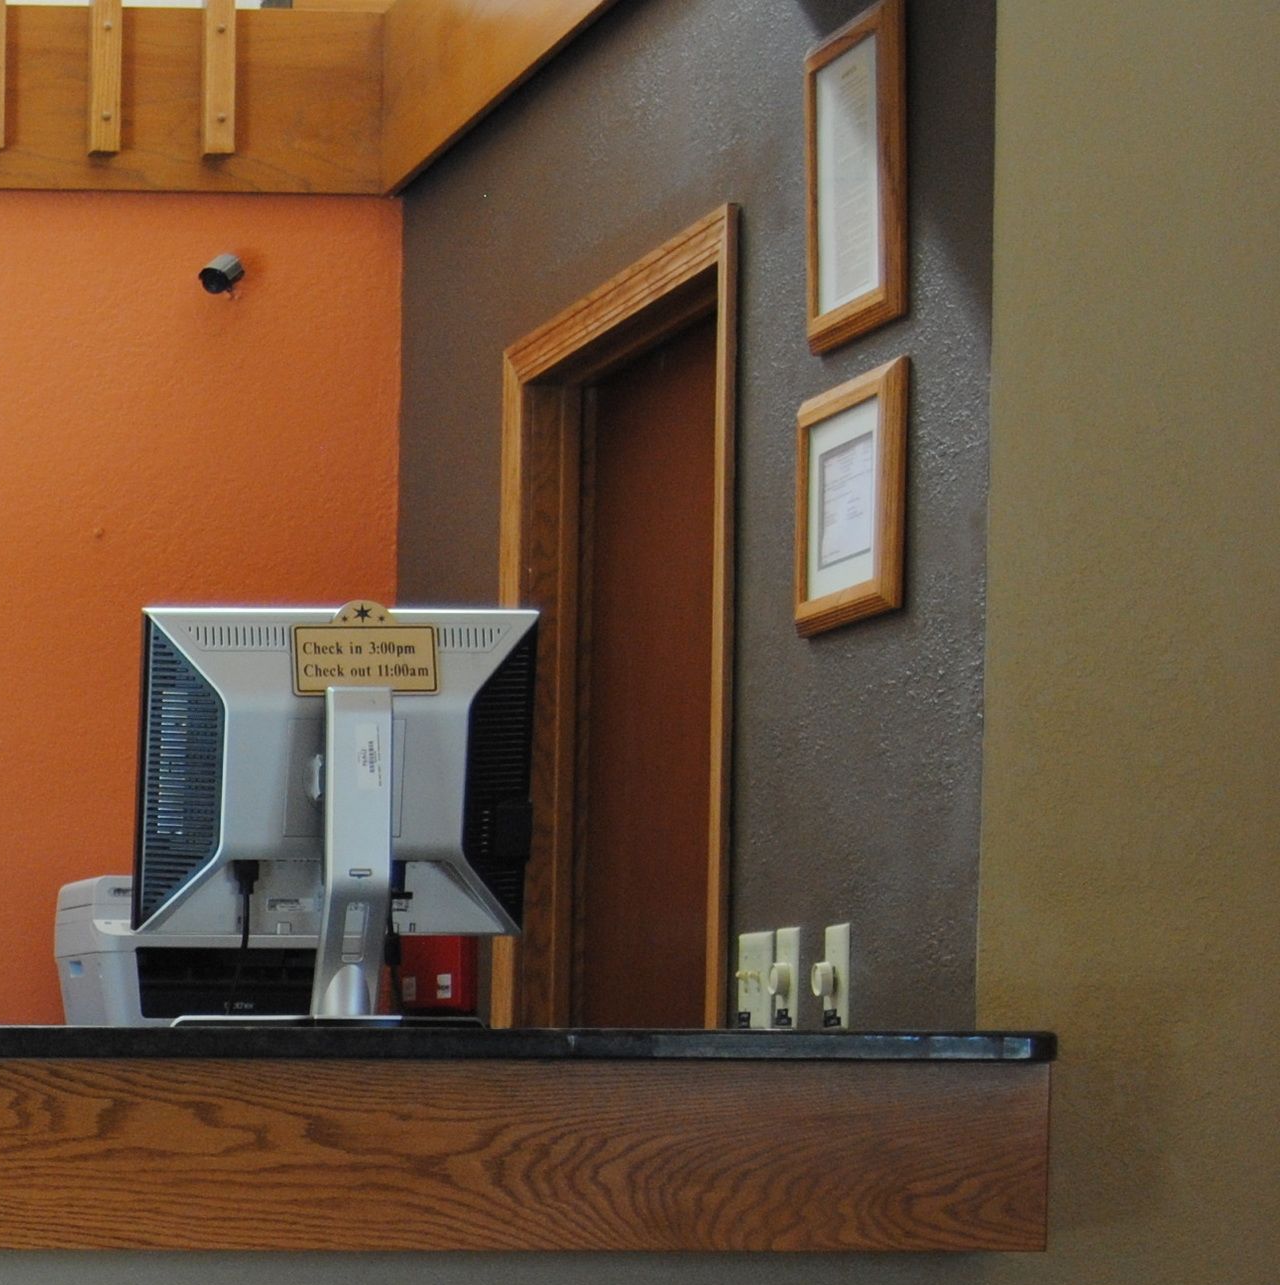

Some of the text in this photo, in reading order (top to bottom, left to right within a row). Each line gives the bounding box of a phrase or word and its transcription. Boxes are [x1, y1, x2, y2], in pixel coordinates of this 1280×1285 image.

[302, 641, 416, 657] Check in 3:00pm
[303, 663, 429, 677] Check out 11:00am
